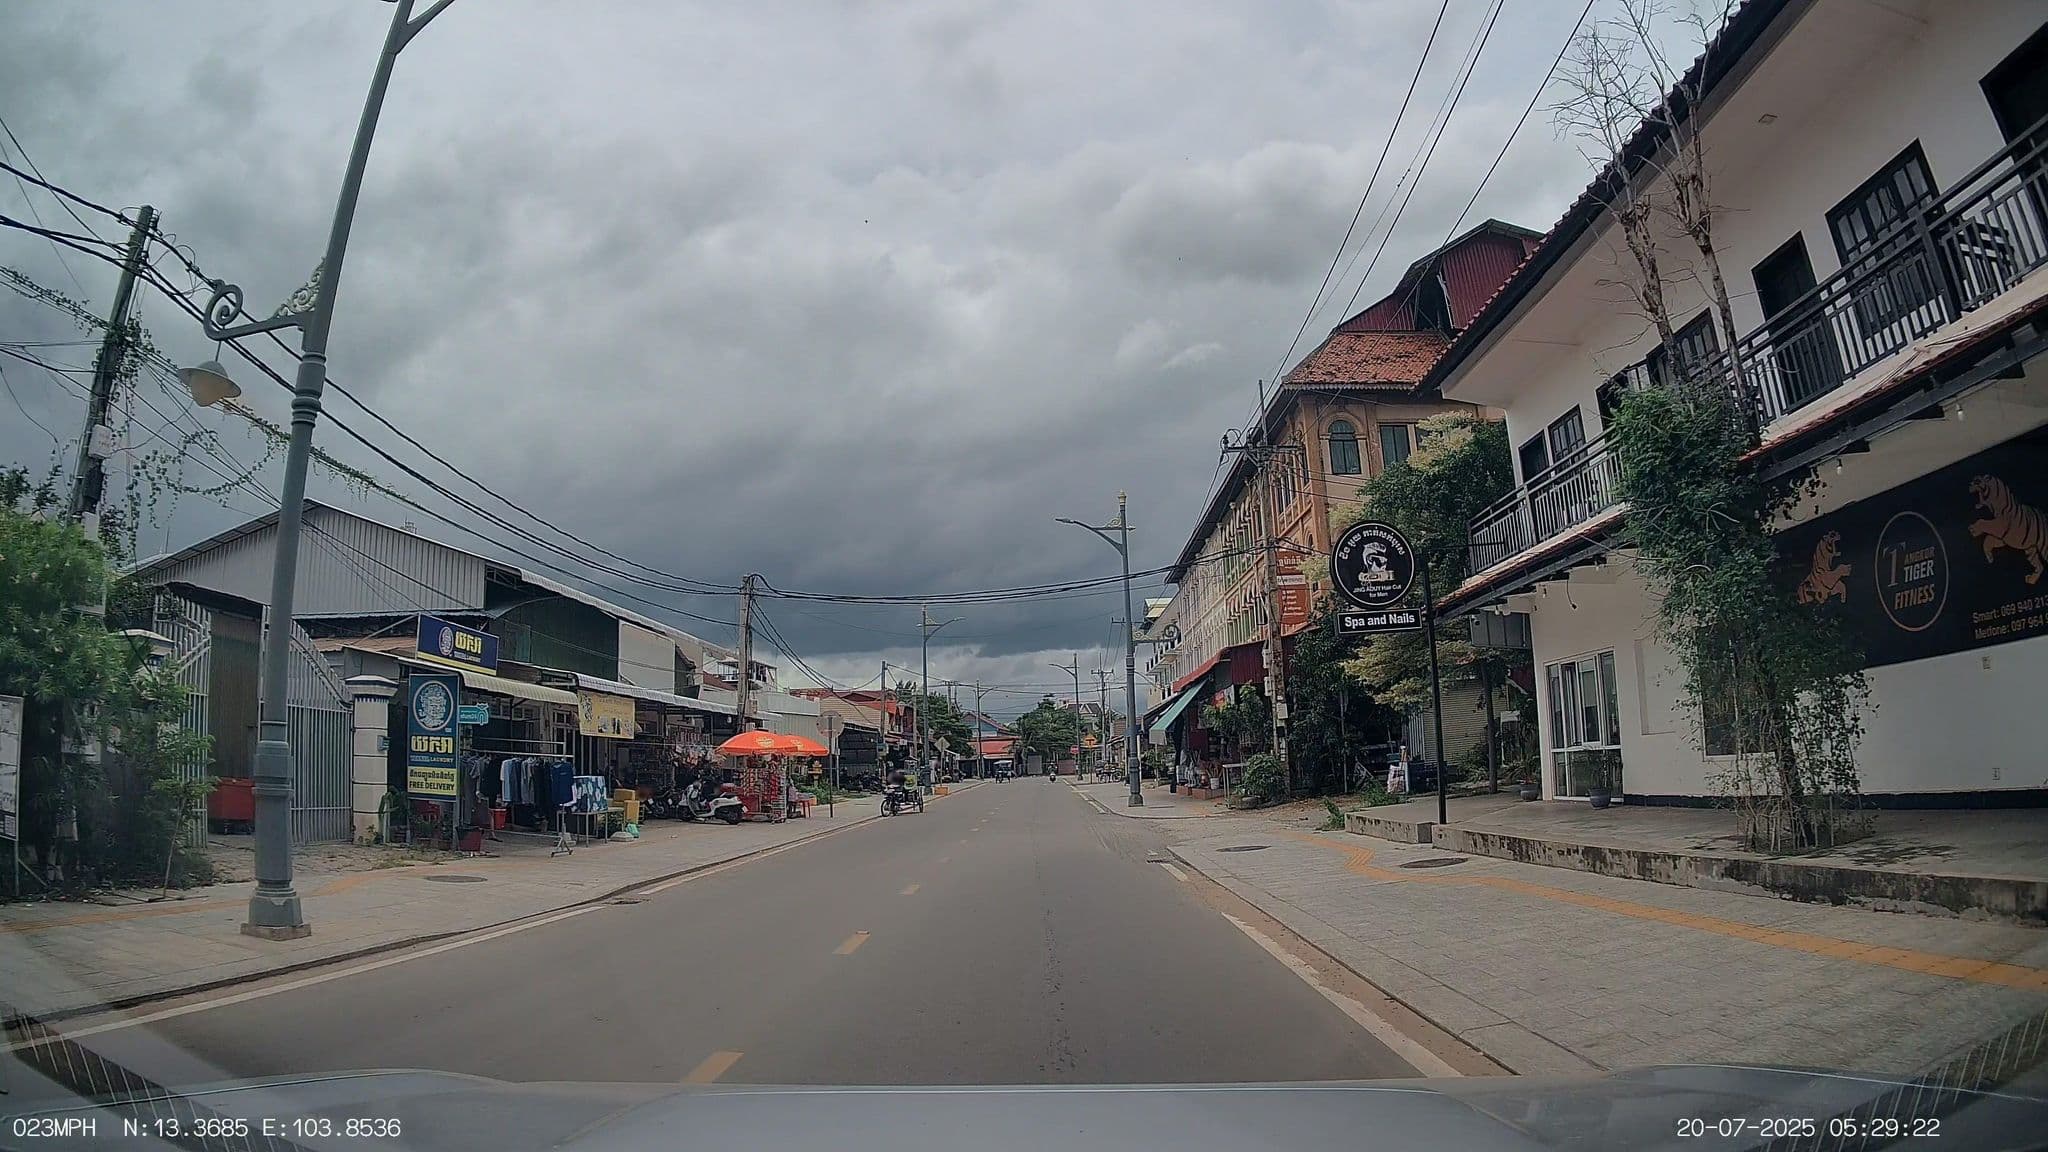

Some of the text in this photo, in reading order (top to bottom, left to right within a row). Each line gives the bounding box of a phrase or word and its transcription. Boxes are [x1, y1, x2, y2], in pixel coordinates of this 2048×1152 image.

[1904, 559, 1935, 583] TIGER
[1894, 584, 1936, 610] FITNESS
[1344, 612, 1415, 629] Spa and Nails
[1972, 608, 2000, 624] Smart:
[2000, 602, 2016, 617] 069
[2016, 598, 2033, 614] 940
[1974, 624, 2010, 640] Metfone:
[2010, 618, 2026, 632] 097
[409, 781, 454, 790] FREE DELIVERY
